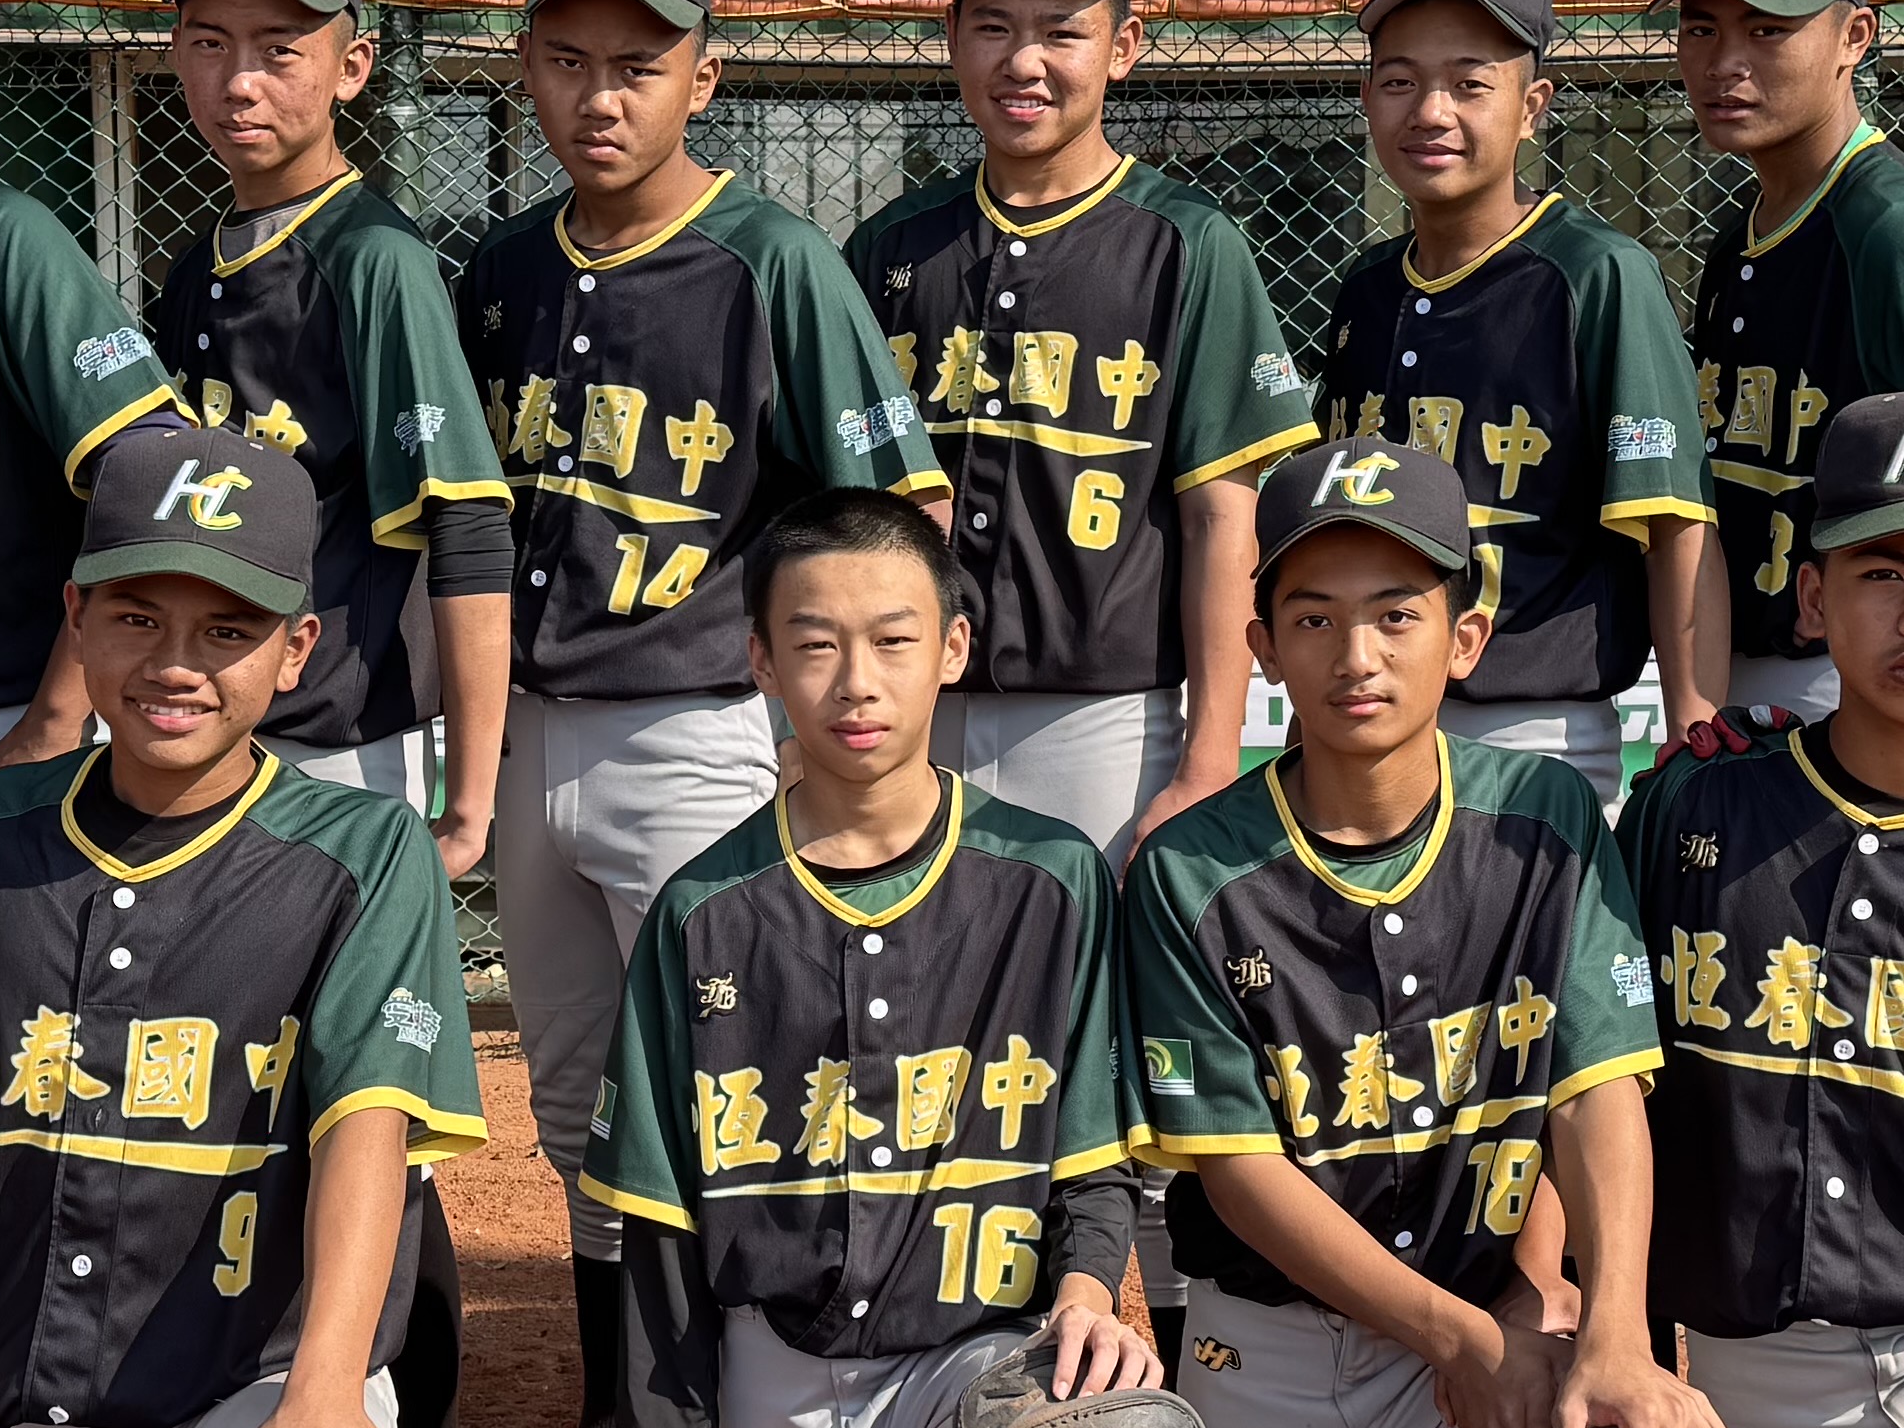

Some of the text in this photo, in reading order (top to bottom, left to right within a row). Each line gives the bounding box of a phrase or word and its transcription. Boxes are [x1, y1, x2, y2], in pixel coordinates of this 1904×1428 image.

[1067, 468, 1125, 551] 6
[608, 533, 710, 615] 14
[693, 1034, 1058, 1175] 恆春國中
[1464, 1138, 1543, 1235] 18
[213, 1190, 258, 1297] 9
[933, 1202, 1043, 1308] 16
